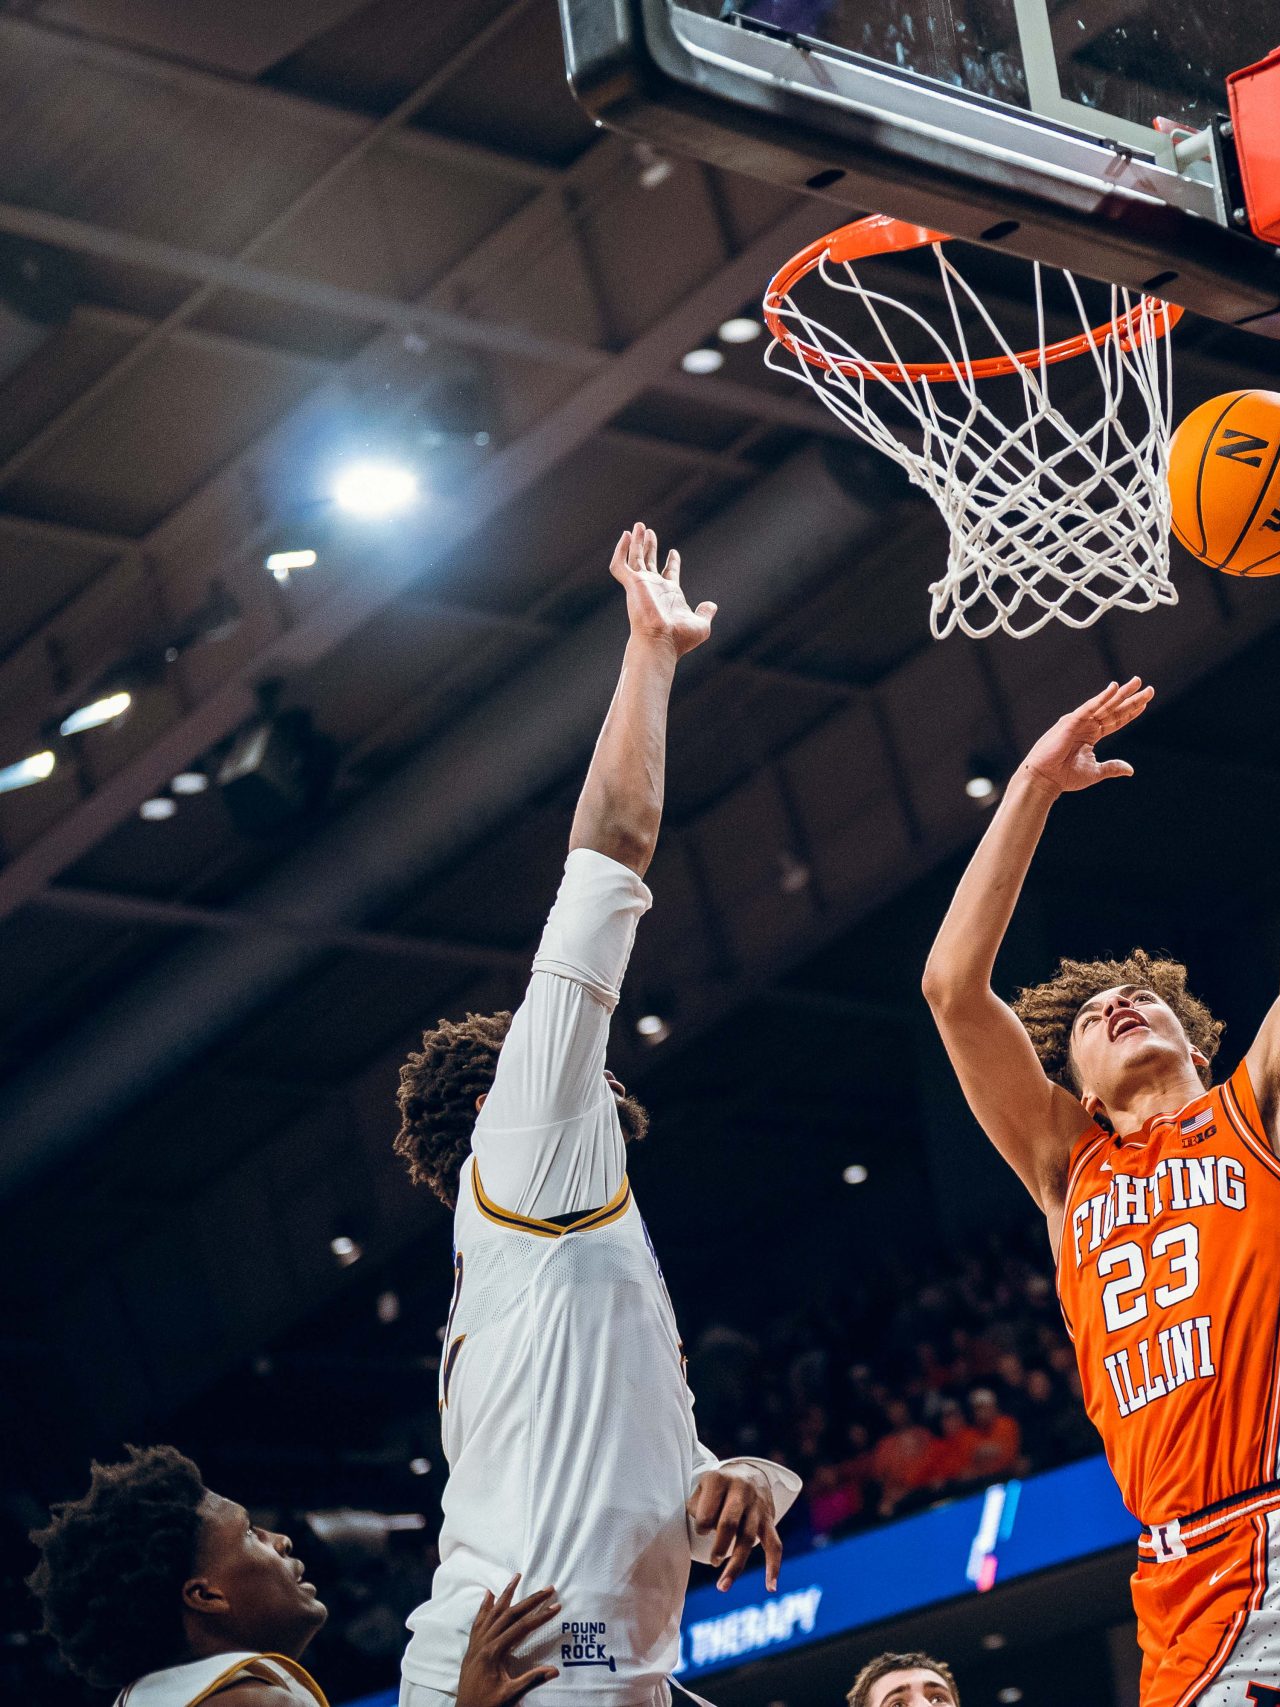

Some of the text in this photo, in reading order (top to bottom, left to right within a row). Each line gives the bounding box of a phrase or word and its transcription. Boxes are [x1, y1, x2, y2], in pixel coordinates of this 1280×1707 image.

[1097, 1222, 1200, 1334] 23
[1103, 1316, 1216, 1418] ILLINI
[562, 1622, 606, 1634] POUND
[572, 1634, 597, 1644] THE
[561, 1644, 607, 1660] ROCK
